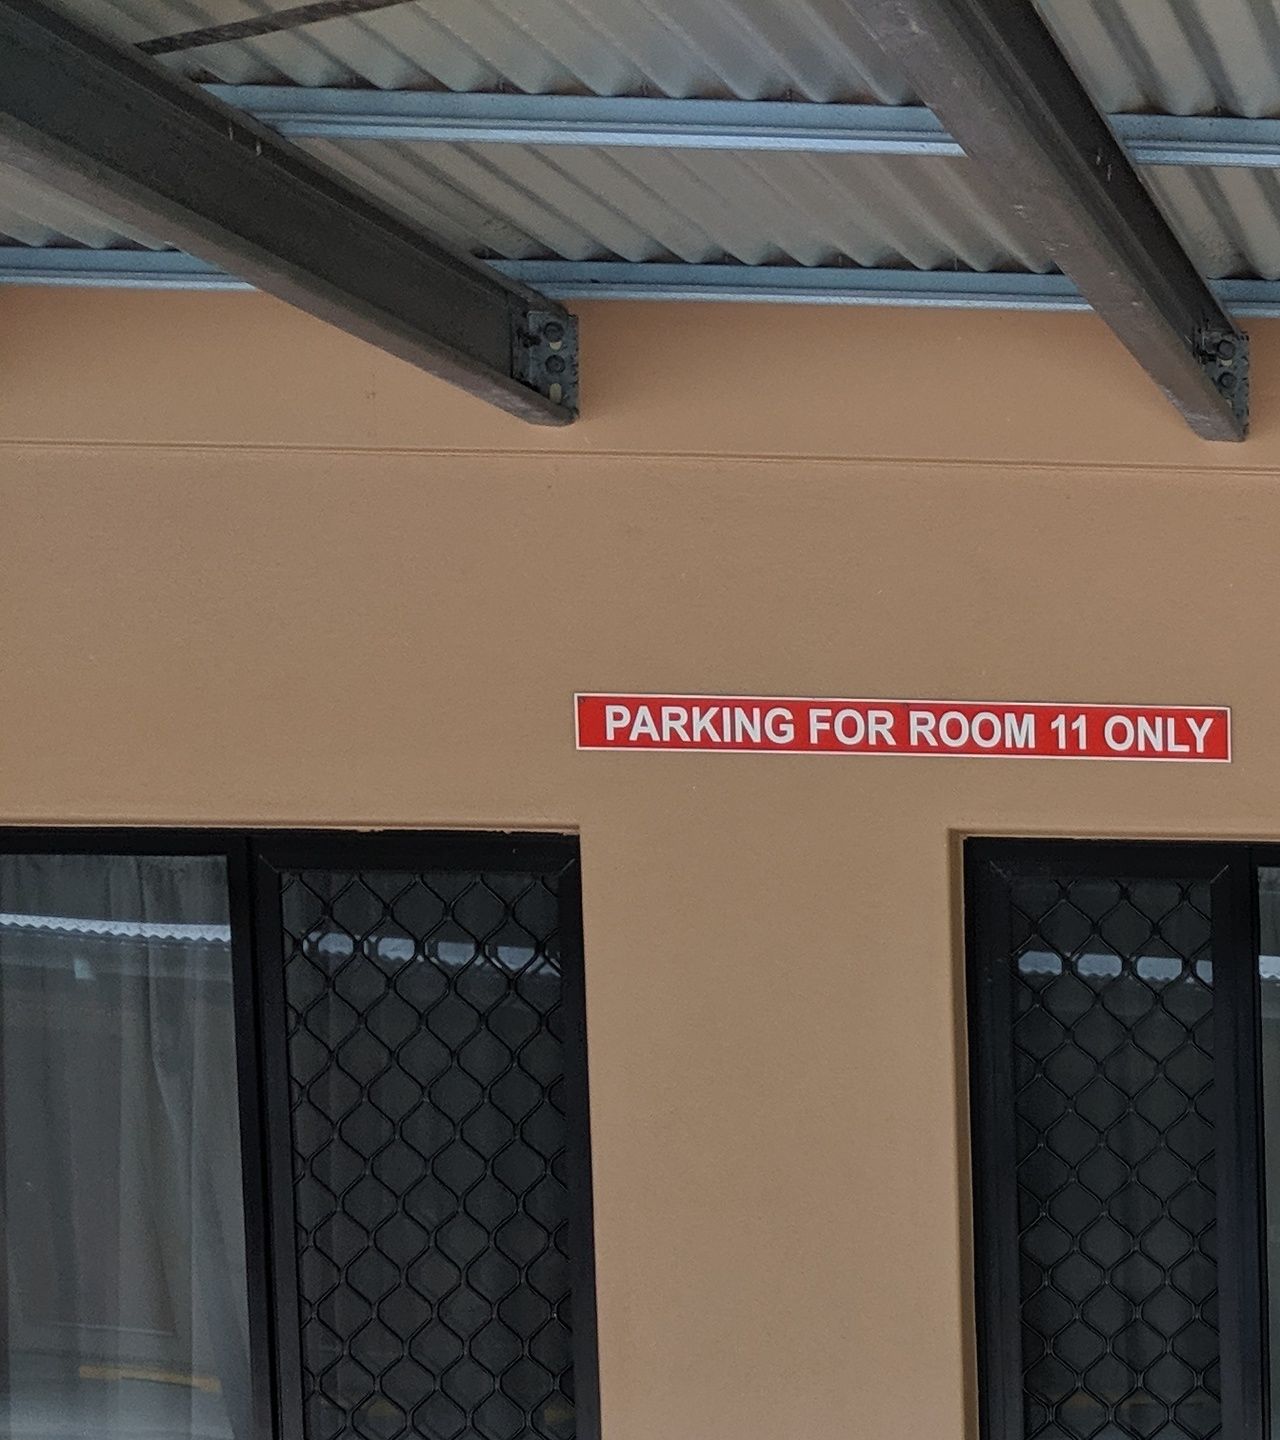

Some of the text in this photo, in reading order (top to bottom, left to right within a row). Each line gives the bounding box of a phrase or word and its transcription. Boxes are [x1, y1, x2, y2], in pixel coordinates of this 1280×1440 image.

[605, 704, 1214, 754] PARKING FOR ROOM 11 ONLY
